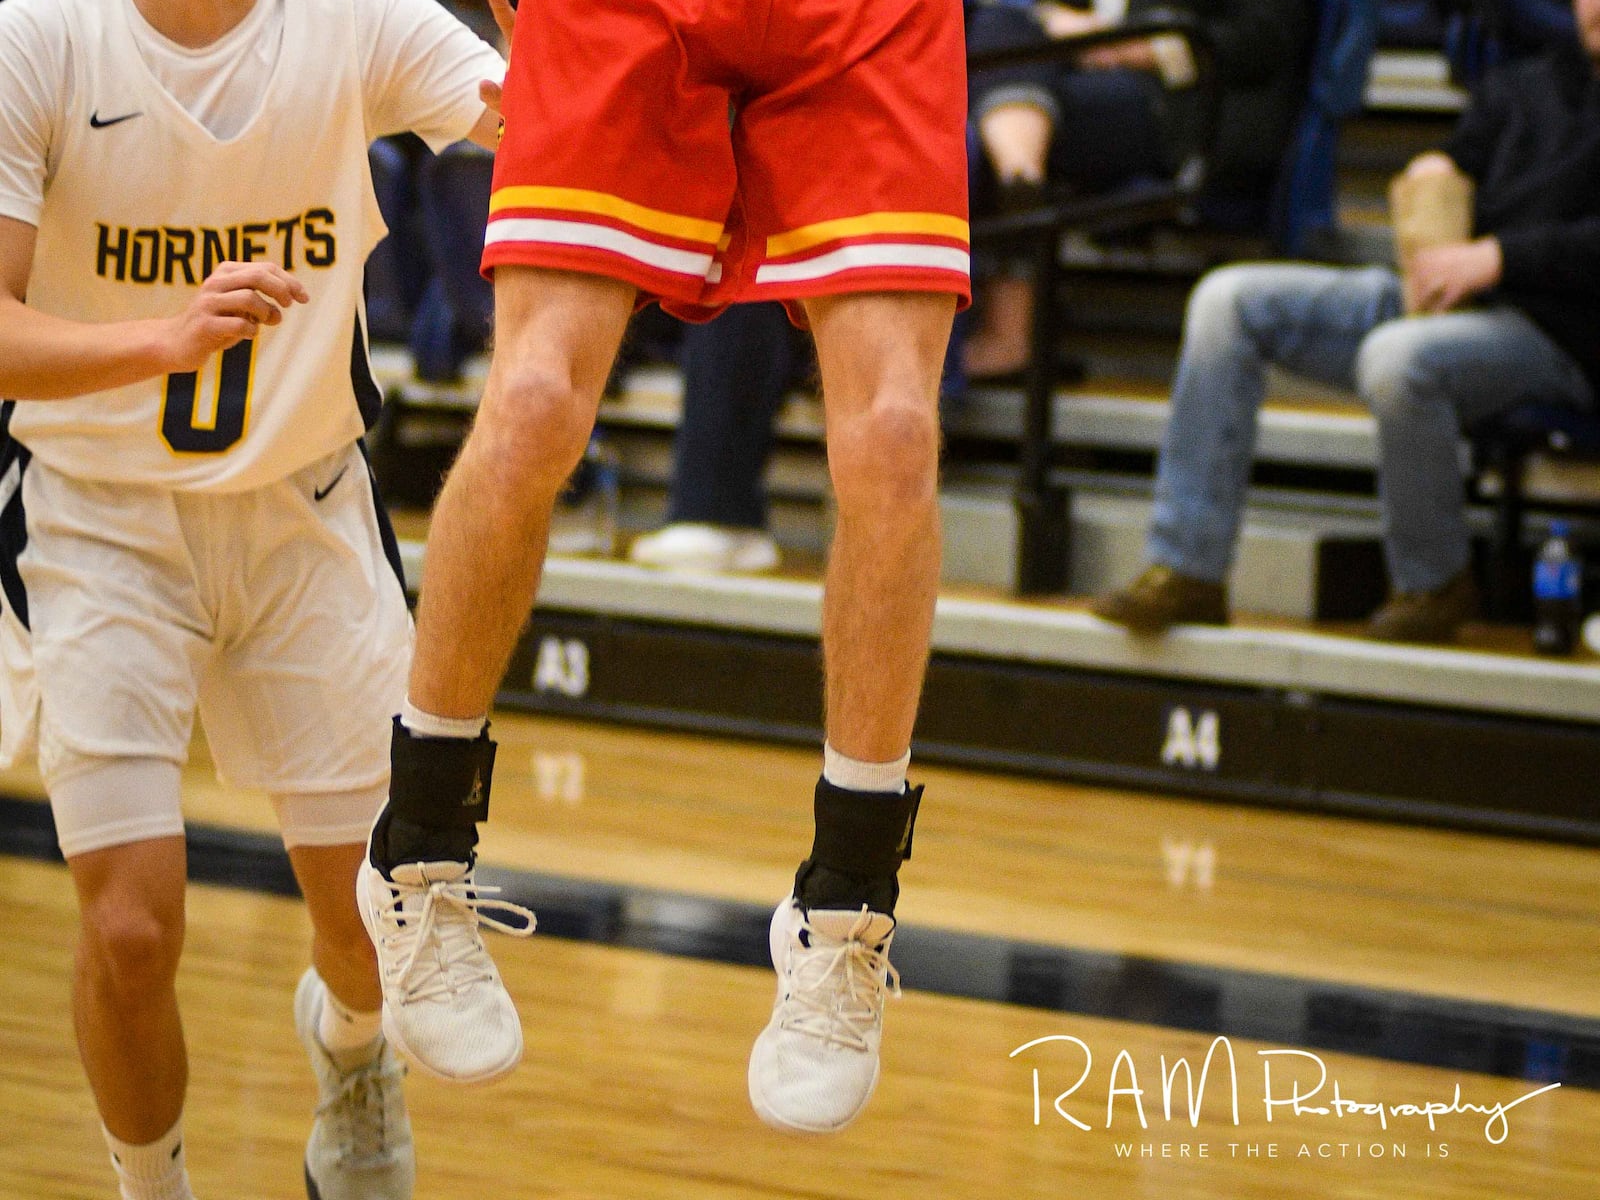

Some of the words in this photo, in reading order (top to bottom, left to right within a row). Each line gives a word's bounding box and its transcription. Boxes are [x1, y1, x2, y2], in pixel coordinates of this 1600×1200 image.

[95, 207, 336, 285] HORNETS
[534, 638, 590, 696] A3
[1162, 707, 1219, 770] A4
